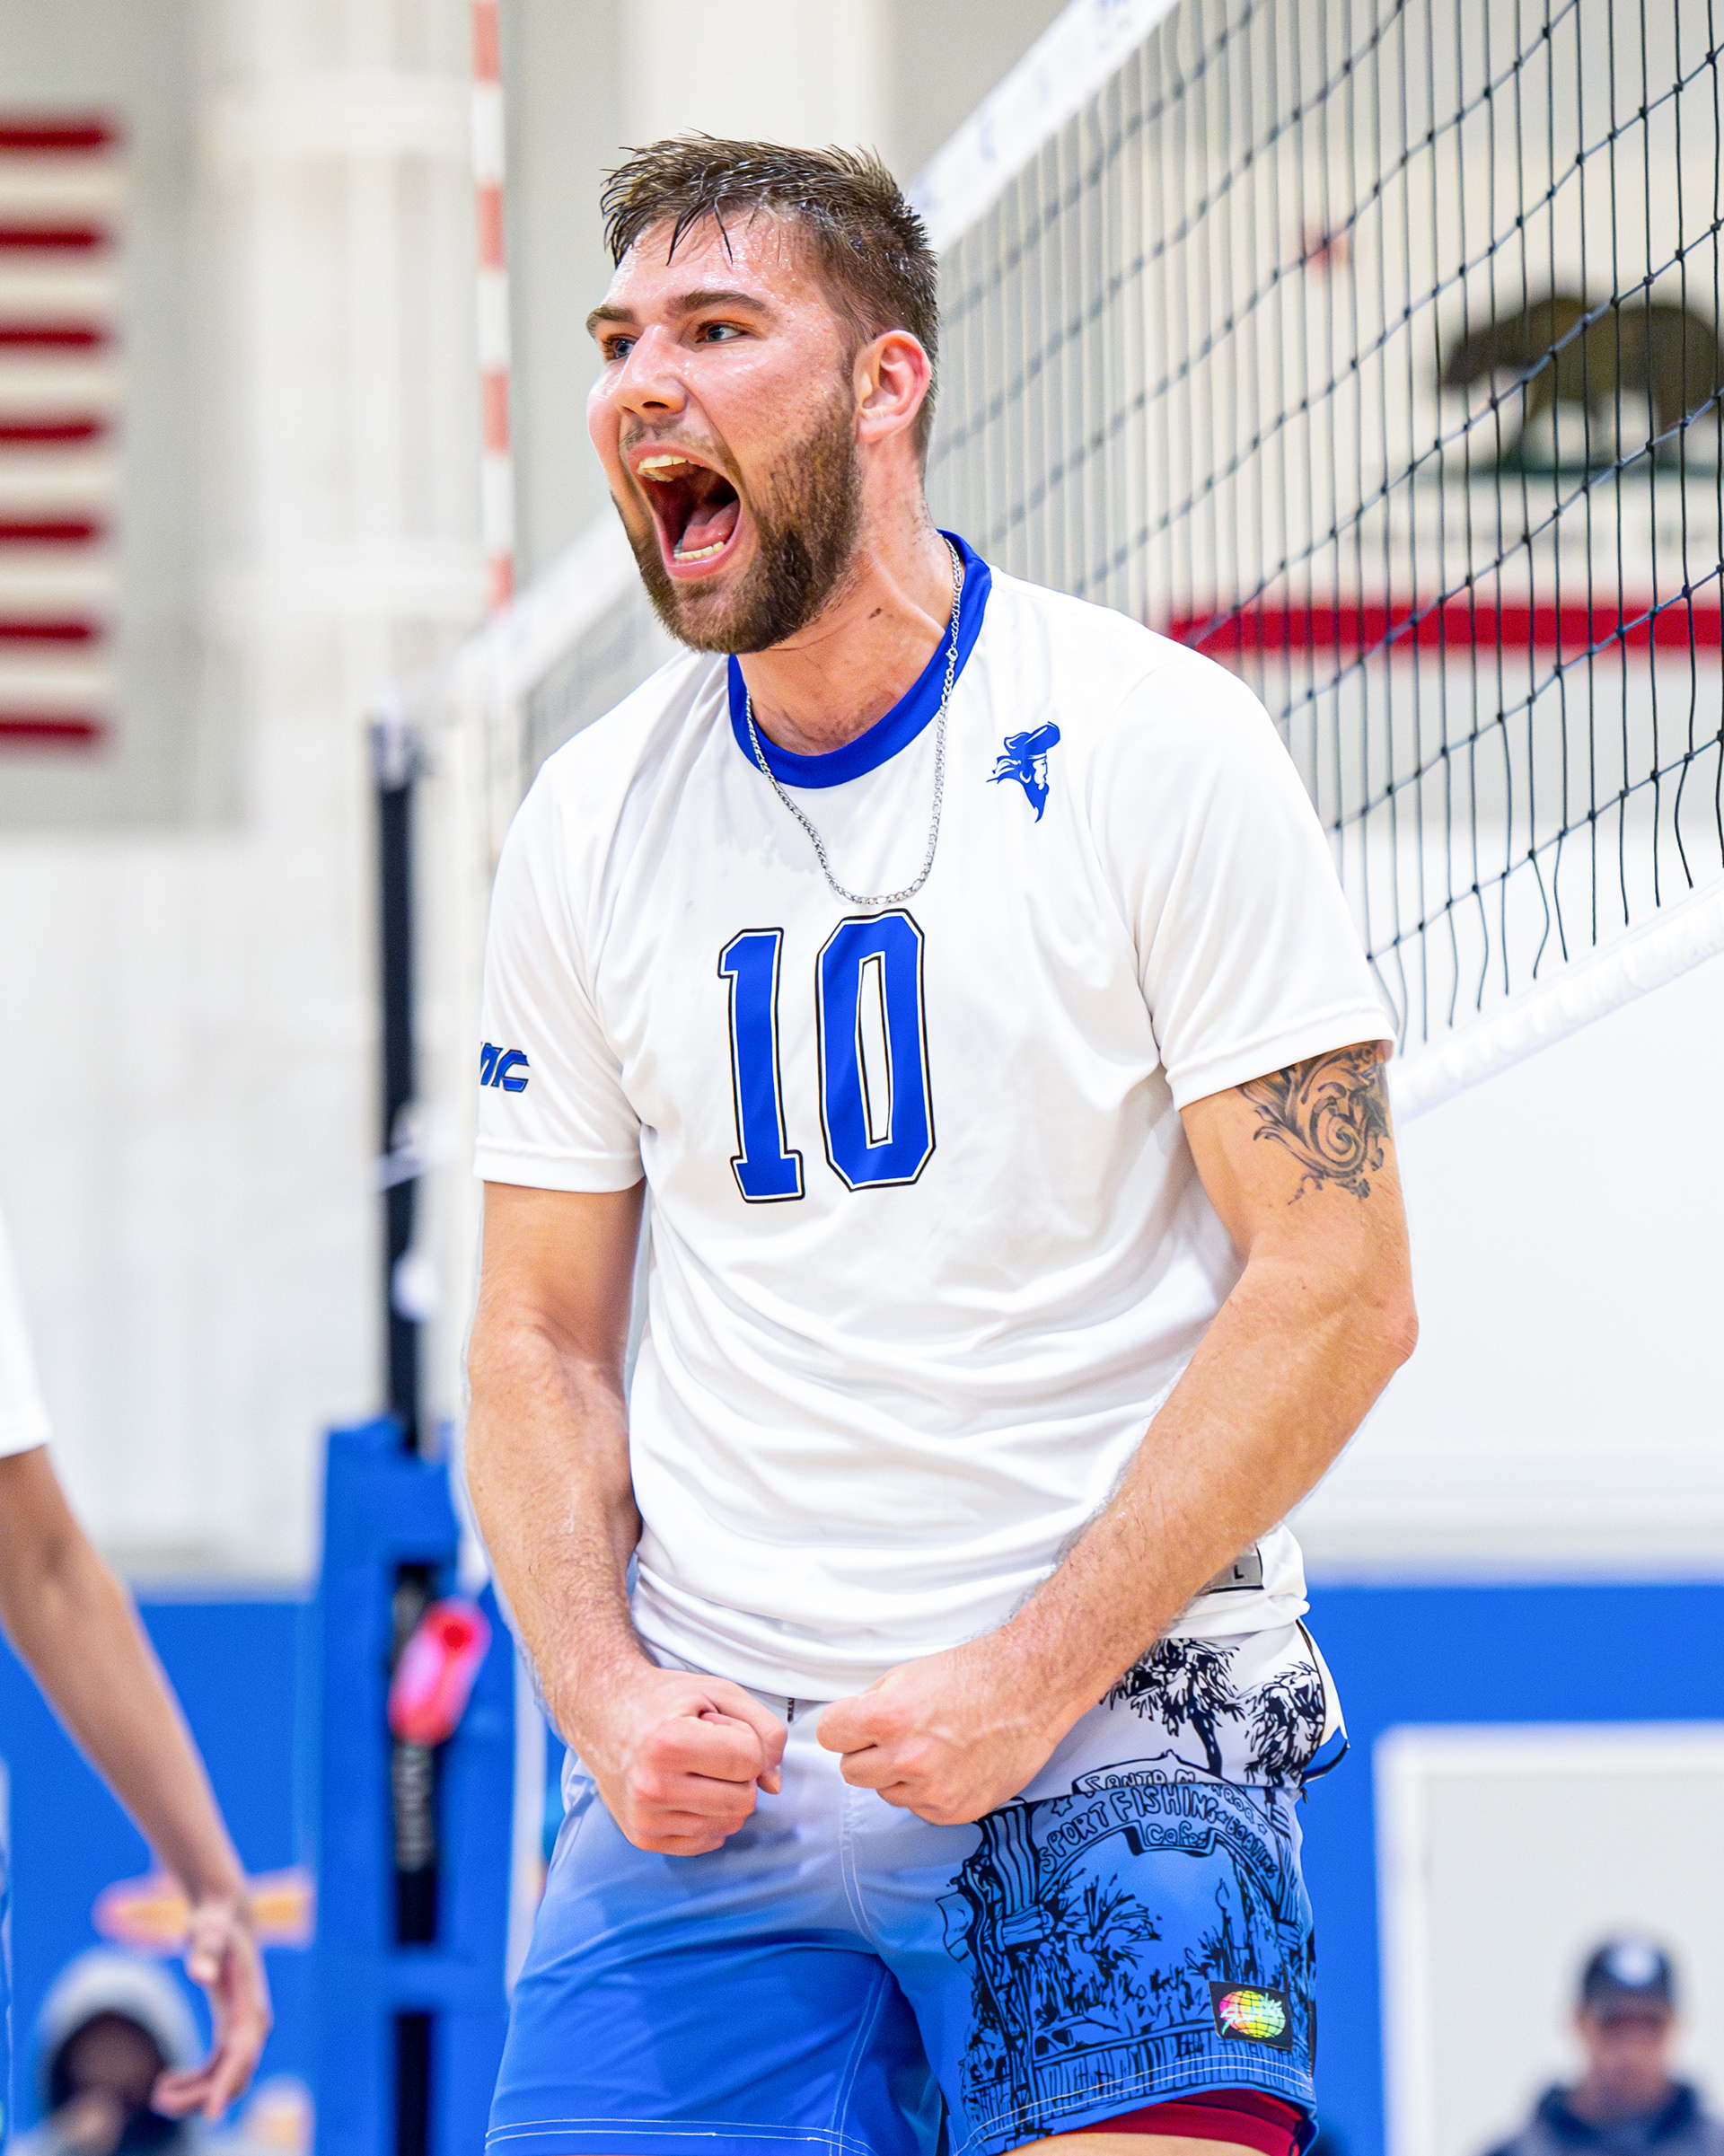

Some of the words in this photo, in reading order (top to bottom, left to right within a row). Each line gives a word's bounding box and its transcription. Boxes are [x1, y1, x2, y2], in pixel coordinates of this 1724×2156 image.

[717, 908, 937, 1204] 10
[1234, 1565, 1245, 1580] L
[1040, 1801, 1110, 1873] SPORT
[1110, 1782, 1218, 1824] FISHING
[1225, 1816, 1280, 1879] BOATING
